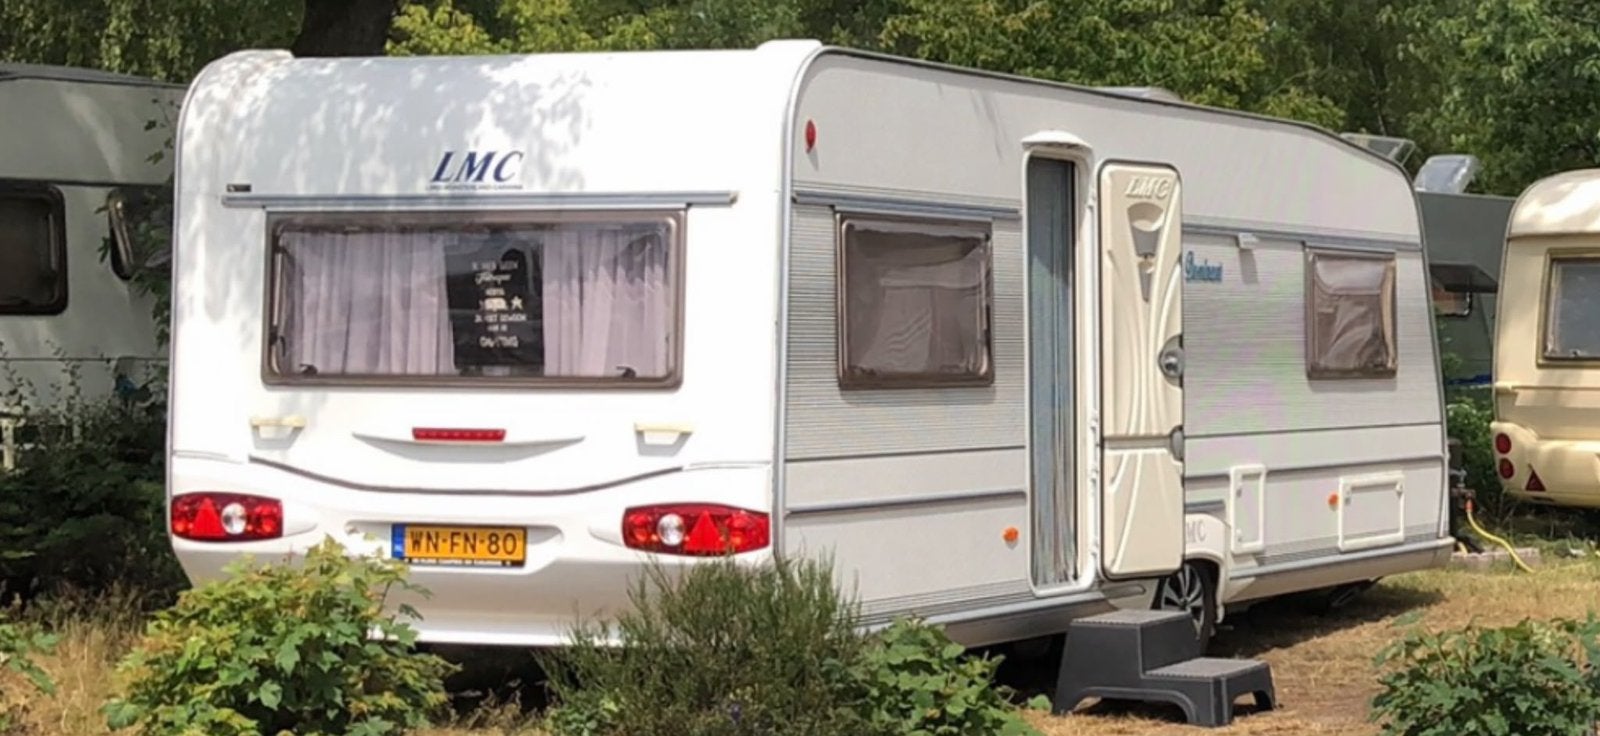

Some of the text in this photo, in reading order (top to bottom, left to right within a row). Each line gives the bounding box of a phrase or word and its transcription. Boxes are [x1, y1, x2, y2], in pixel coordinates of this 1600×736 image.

[430, 151, 524, 182] LMC
[1124, 177, 1169, 200] LMC
[410, 530, 518, 556] WN-FN-80
